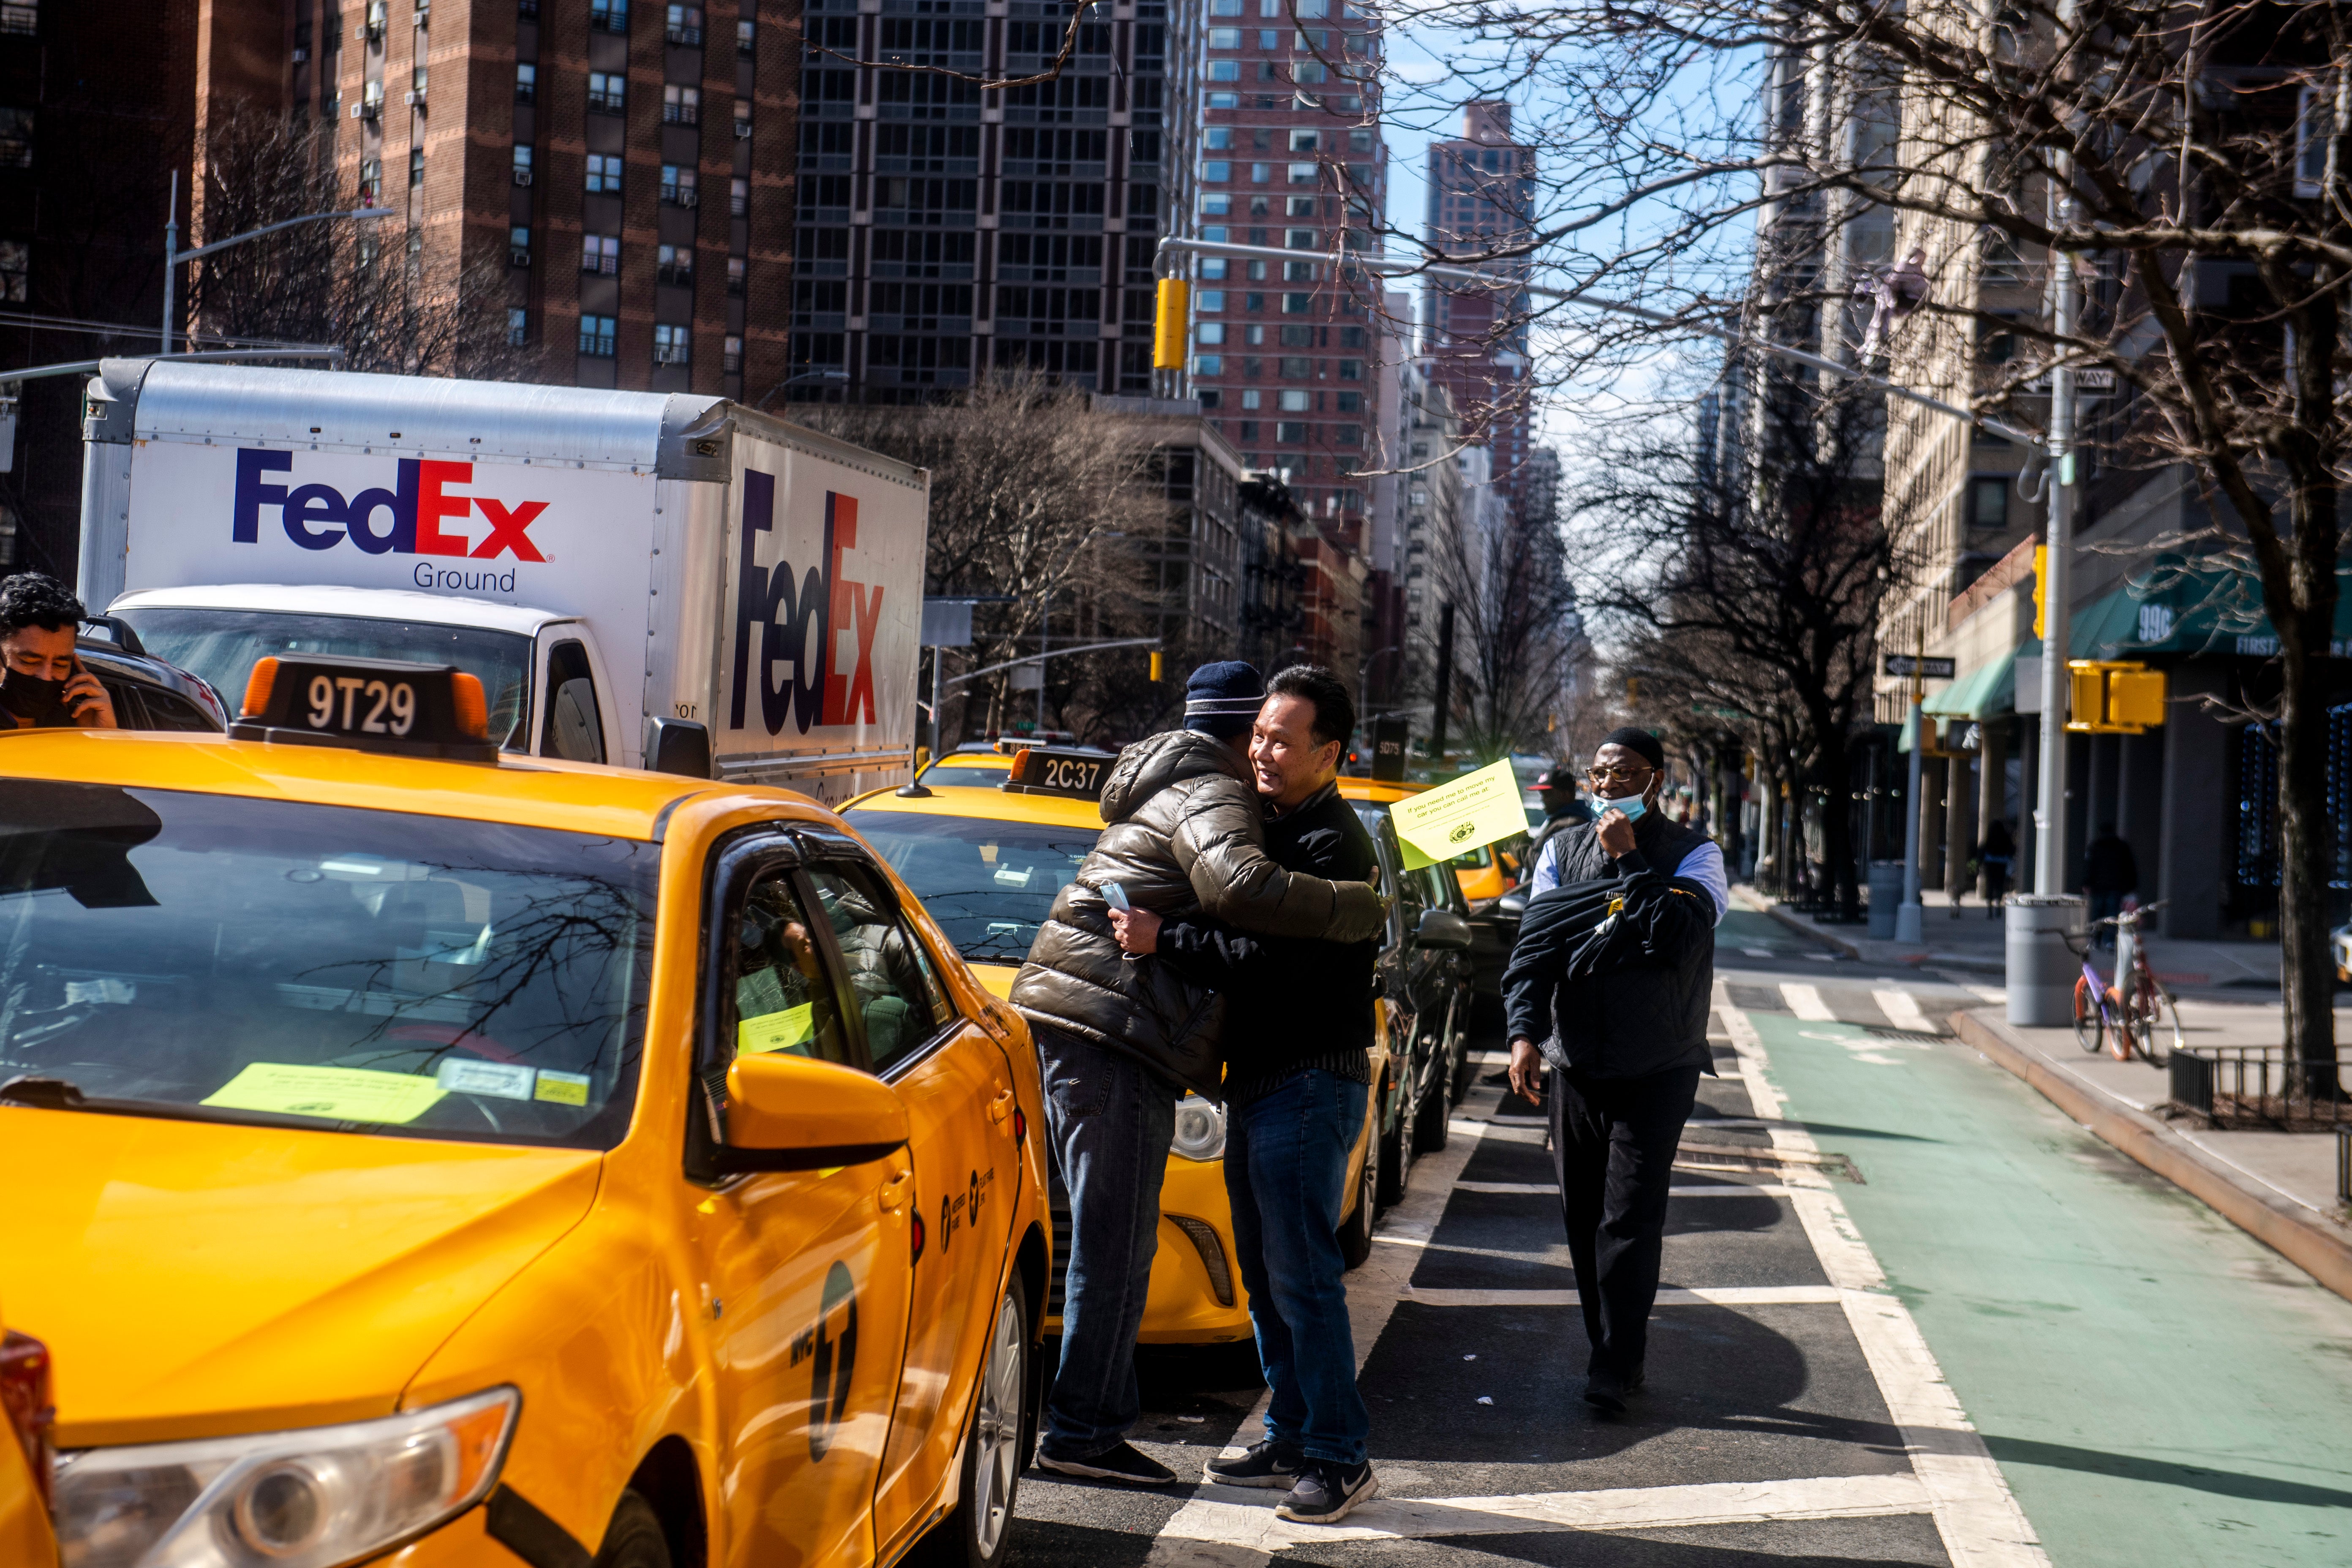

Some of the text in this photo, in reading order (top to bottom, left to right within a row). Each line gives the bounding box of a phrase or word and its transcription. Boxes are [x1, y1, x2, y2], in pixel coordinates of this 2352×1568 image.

[2073, 371, 2103, 385] WAY
[233, 448, 550, 563] FedEx
[414, 563, 515, 592] Ground
[730, 468, 884, 736] FedEx
[307, 675, 416, 736] 9T29
[1045, 760, 1100, 790] 2C37
[1414, 804, 1426, 812] you
[1428, 796, 1444, 806] need
[1465, 781, 1484, 791] move
[1429, 806, 1442, 814] you
[1457, 795, 1468, 803] call
